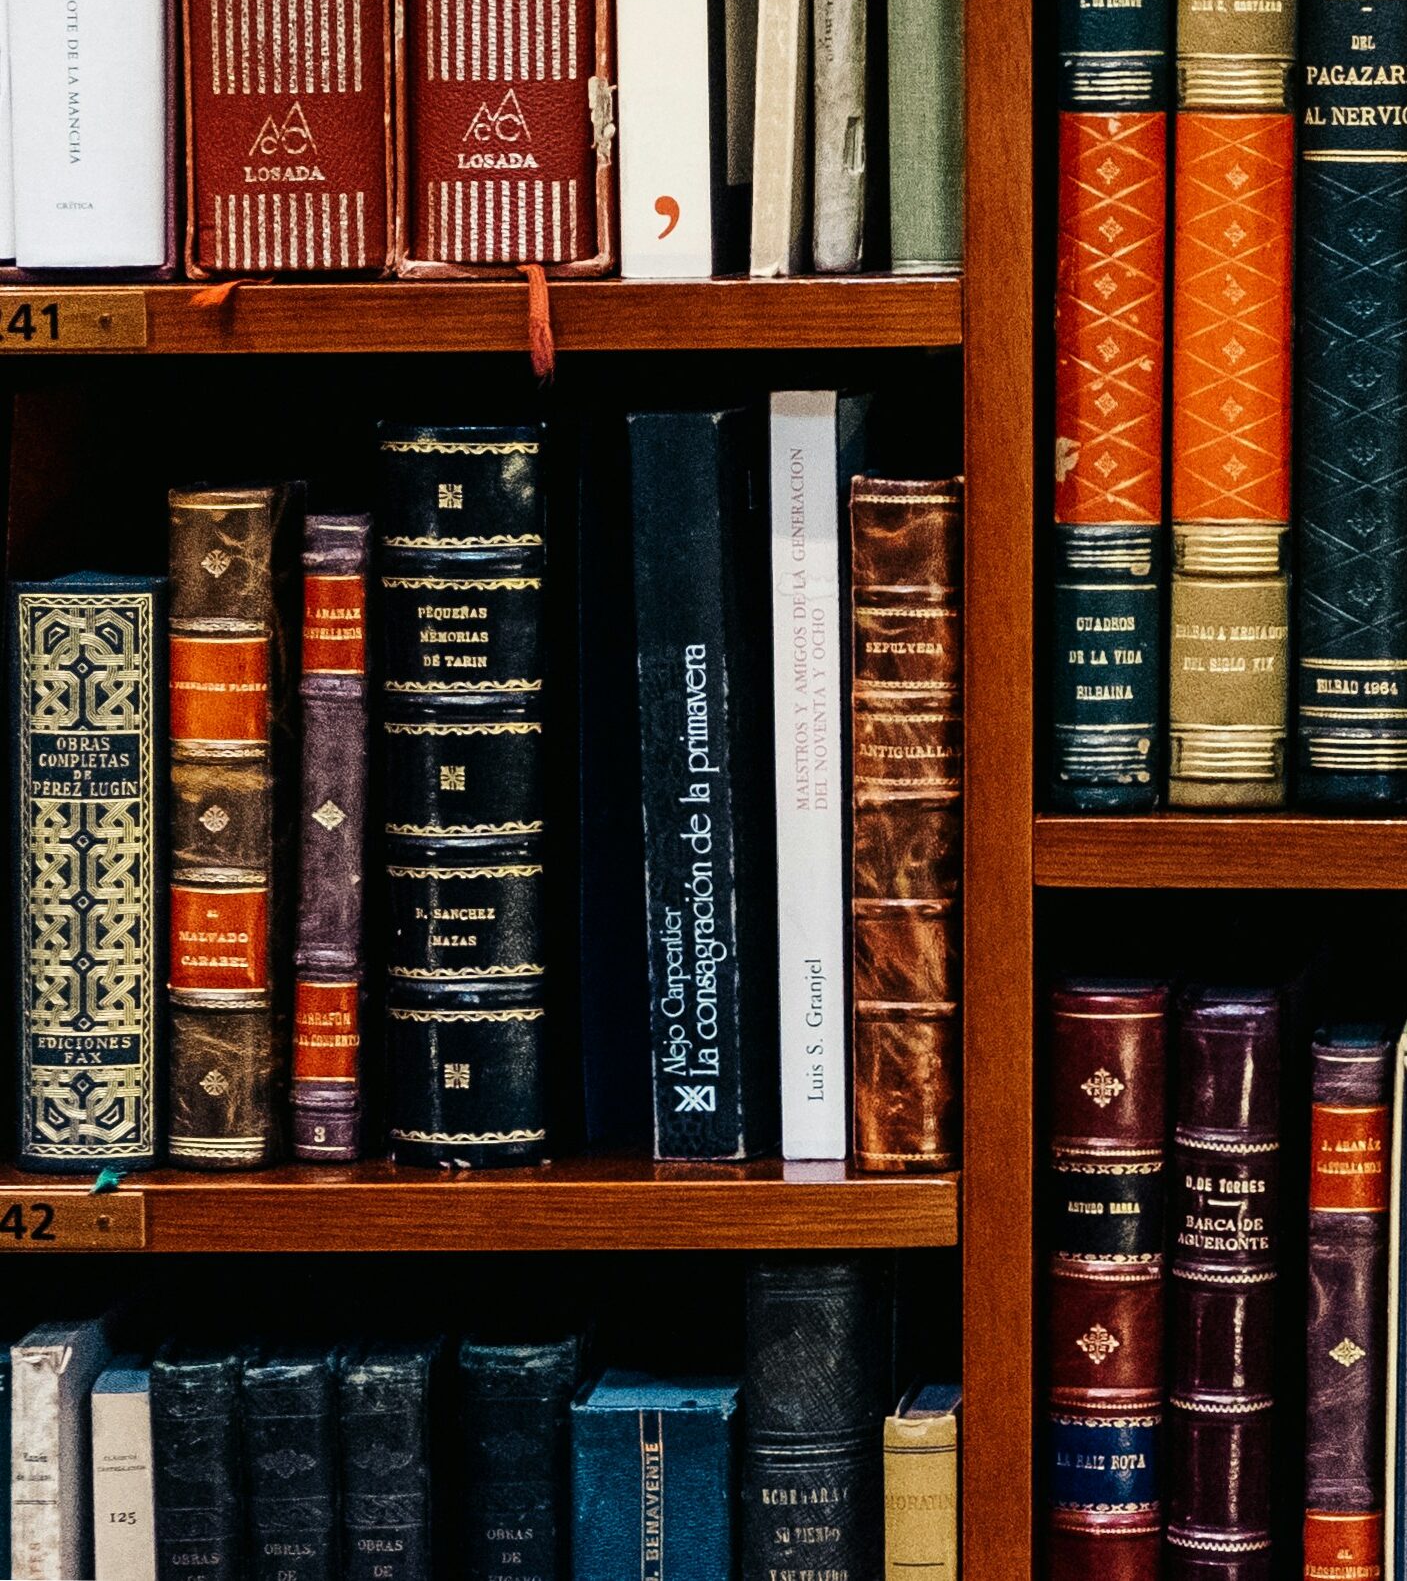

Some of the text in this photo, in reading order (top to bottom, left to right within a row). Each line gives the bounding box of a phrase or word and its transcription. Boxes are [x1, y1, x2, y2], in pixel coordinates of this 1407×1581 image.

[67, 38, 79, 60] DE
[1351, 34, 1376, 50] DEL
[67, 65, 79, 86] LA
[1304, 106, 1326, 126] AL
[67, 91, 81, 165] MANCHA
[457, 153, 539, 169] LOSADA
[244, 166, 326, 182] LOSADA
[811, 607, 829, 811] DEL NOVENTA Y OCHO
[680, 643, 720, 804] la primavera
[56, 736, 110, 753] OBRAS
[38, 752, 130, 769] COMPLETAS
[73, 769, 92, 781] DE
[661, 906, 694, 1075] Alejo Carpentier
[805, 957, 826, 1102] Luis S. Granjel
[37, 1035, 132, 1050] EDICIONES
[64, 1049, 102, 1065] FAX
[313, 1126, 325, 1143] 3
[644, 1441, 661, 1561] BENAVENTE
